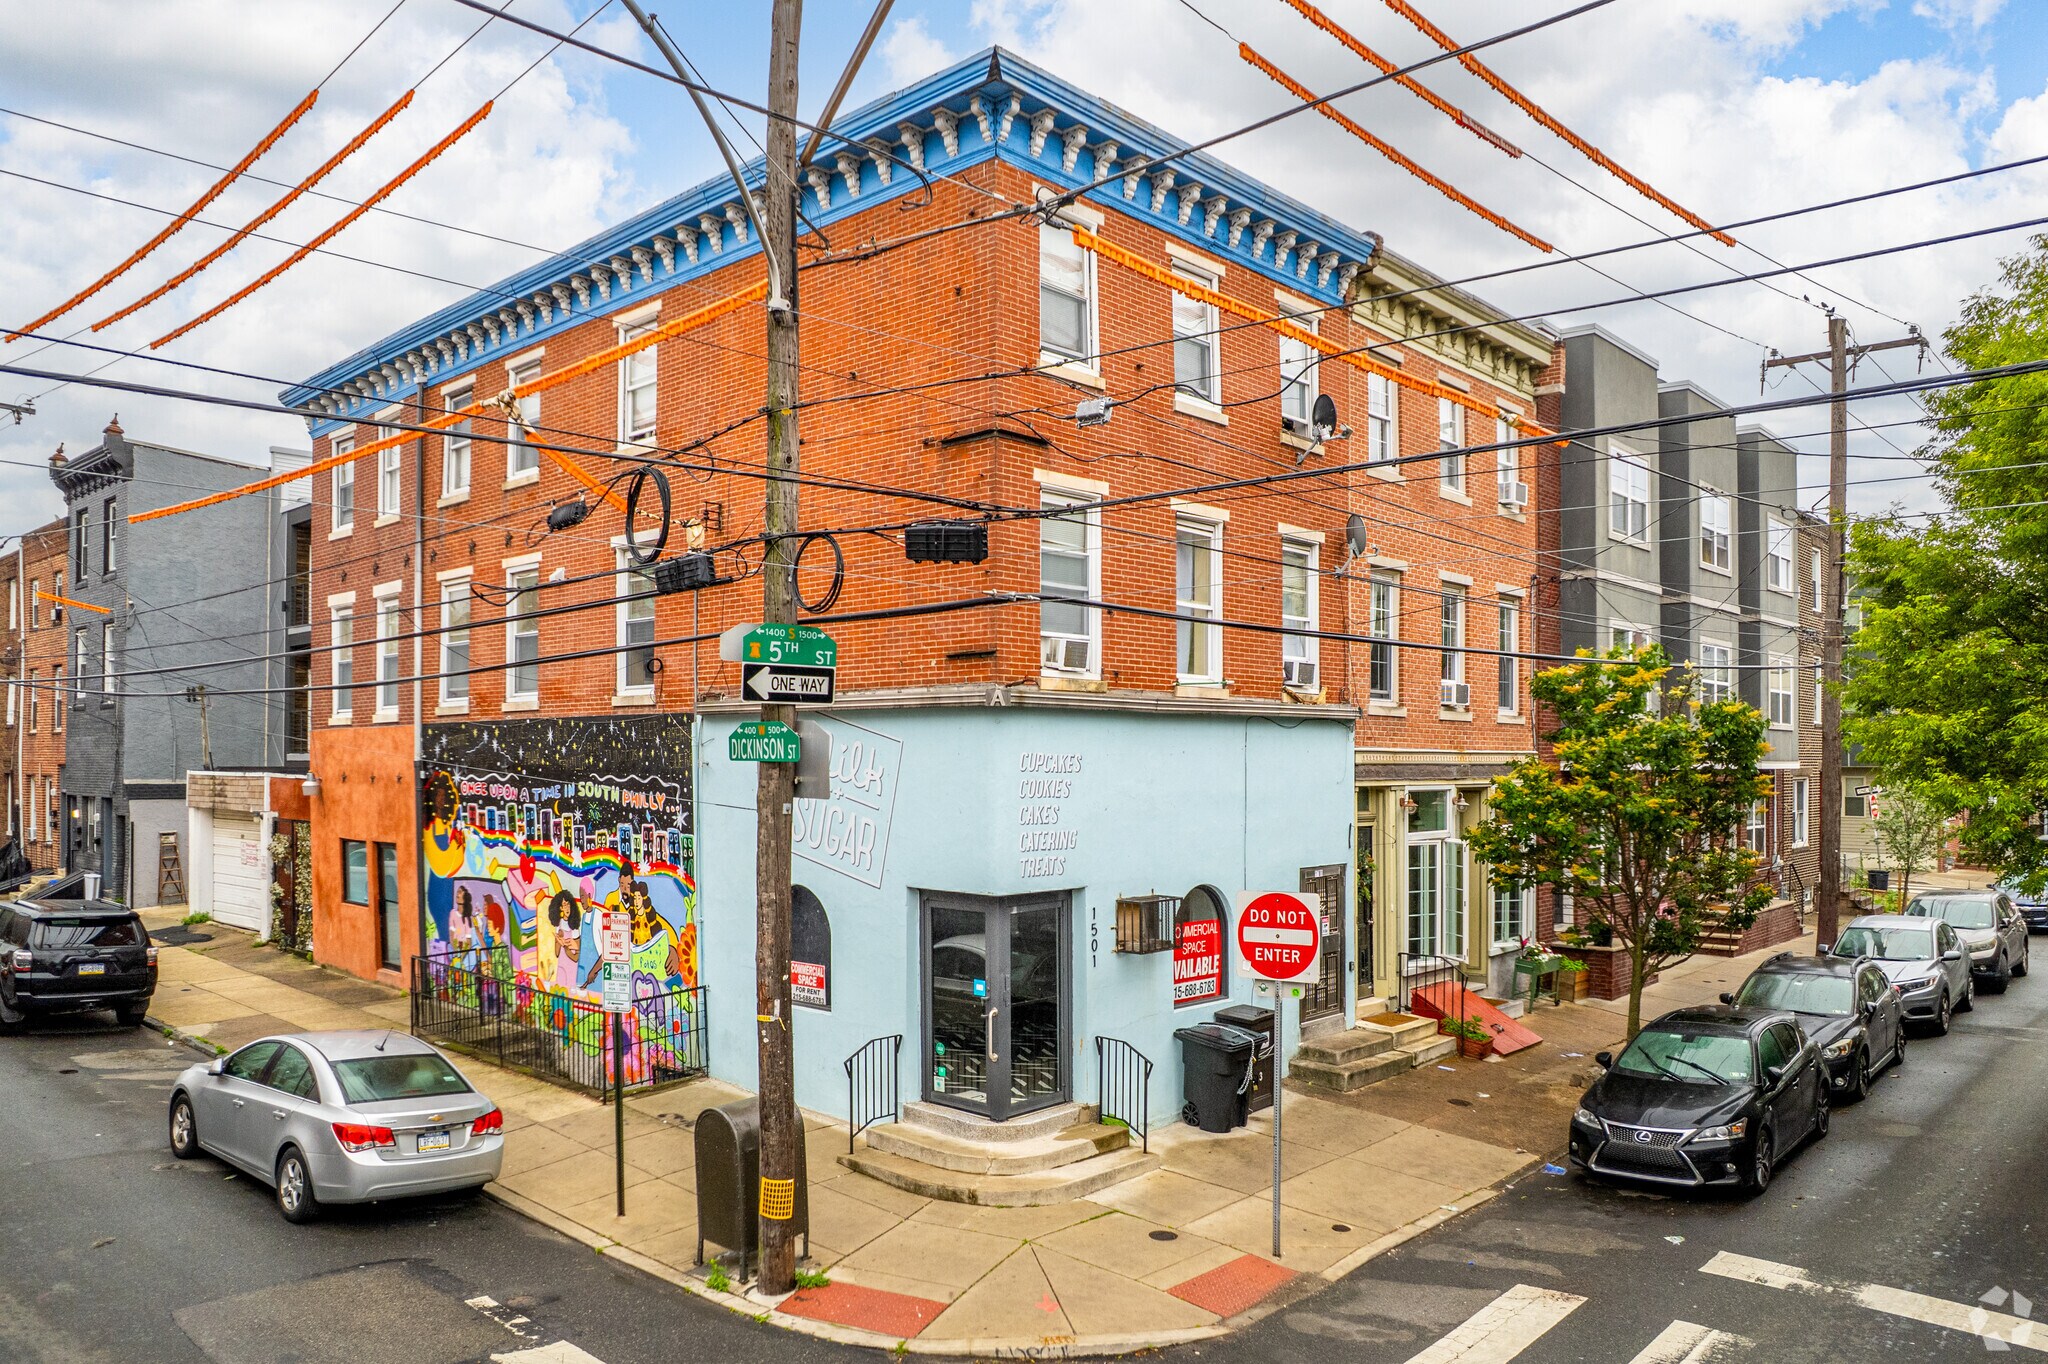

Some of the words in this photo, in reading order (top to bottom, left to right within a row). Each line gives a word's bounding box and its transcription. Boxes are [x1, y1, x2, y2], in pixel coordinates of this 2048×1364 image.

[765, 628, 785, 637] 1400
[788, 628, 796, 639] S
[799, 630, 817, 639] 1500
[815, 650, 833, 665] ST
[771, 676, 796, 691] ONE
[800, 678, 826, 692] WAY
[990, 689, 1006, 707] A
[744, 726, 756, 735] 400
[758, 724, 765, 736] W
[768, 726, 781, 734] 500
[731, 737, 784, 760] DICKINSON
[787, 744, 797, 759] ST
[830, 740, 884, 796] ilk
[1019, 752, 1082, 774] CUPCAKES
[460, 780, 488, 796] ONCE
[489, 783, 518, 801] UPON
[519, 787, 530, 803] A
[531, 784, 562, 802] TIME
[564, 781, 576, 798] IN
[577, 781, 620, 804] SOUTH
[1019, 779, 1071, 799] COOKIES
[1019, 805, 1060, 826] CAKES
[793, 798, 876, 872] SUGAR
[1019, 830, 1078, 853] CATERING
[1019, 855, 1066, 878] TREATS
[602, 917, 610, 927] NO
[611, 918, 628, 926] PARKING
[1250, 908, 1270, 923] DO
[1276, 910, 1307, 925] NOT
[610, 932, 623, 940] ANY
[1175, 923, 1218, 939] OMMERCIAL
[610, 941, 623, 949] TIME
[1182, 940, 1206, 955] SPACE
[1255, 947, 1300, 963] ENTER
[604, 964, 610, 978] 2
[791, 963, 824, 977] COMMERCIAL
[1174, 954, 1220, 980] VAILABLE
[611, 972, 630, 980] PARKING
[797, 974, 817, 987] SPACE
[1174, 980, 1215, 999] 15-688-6783
